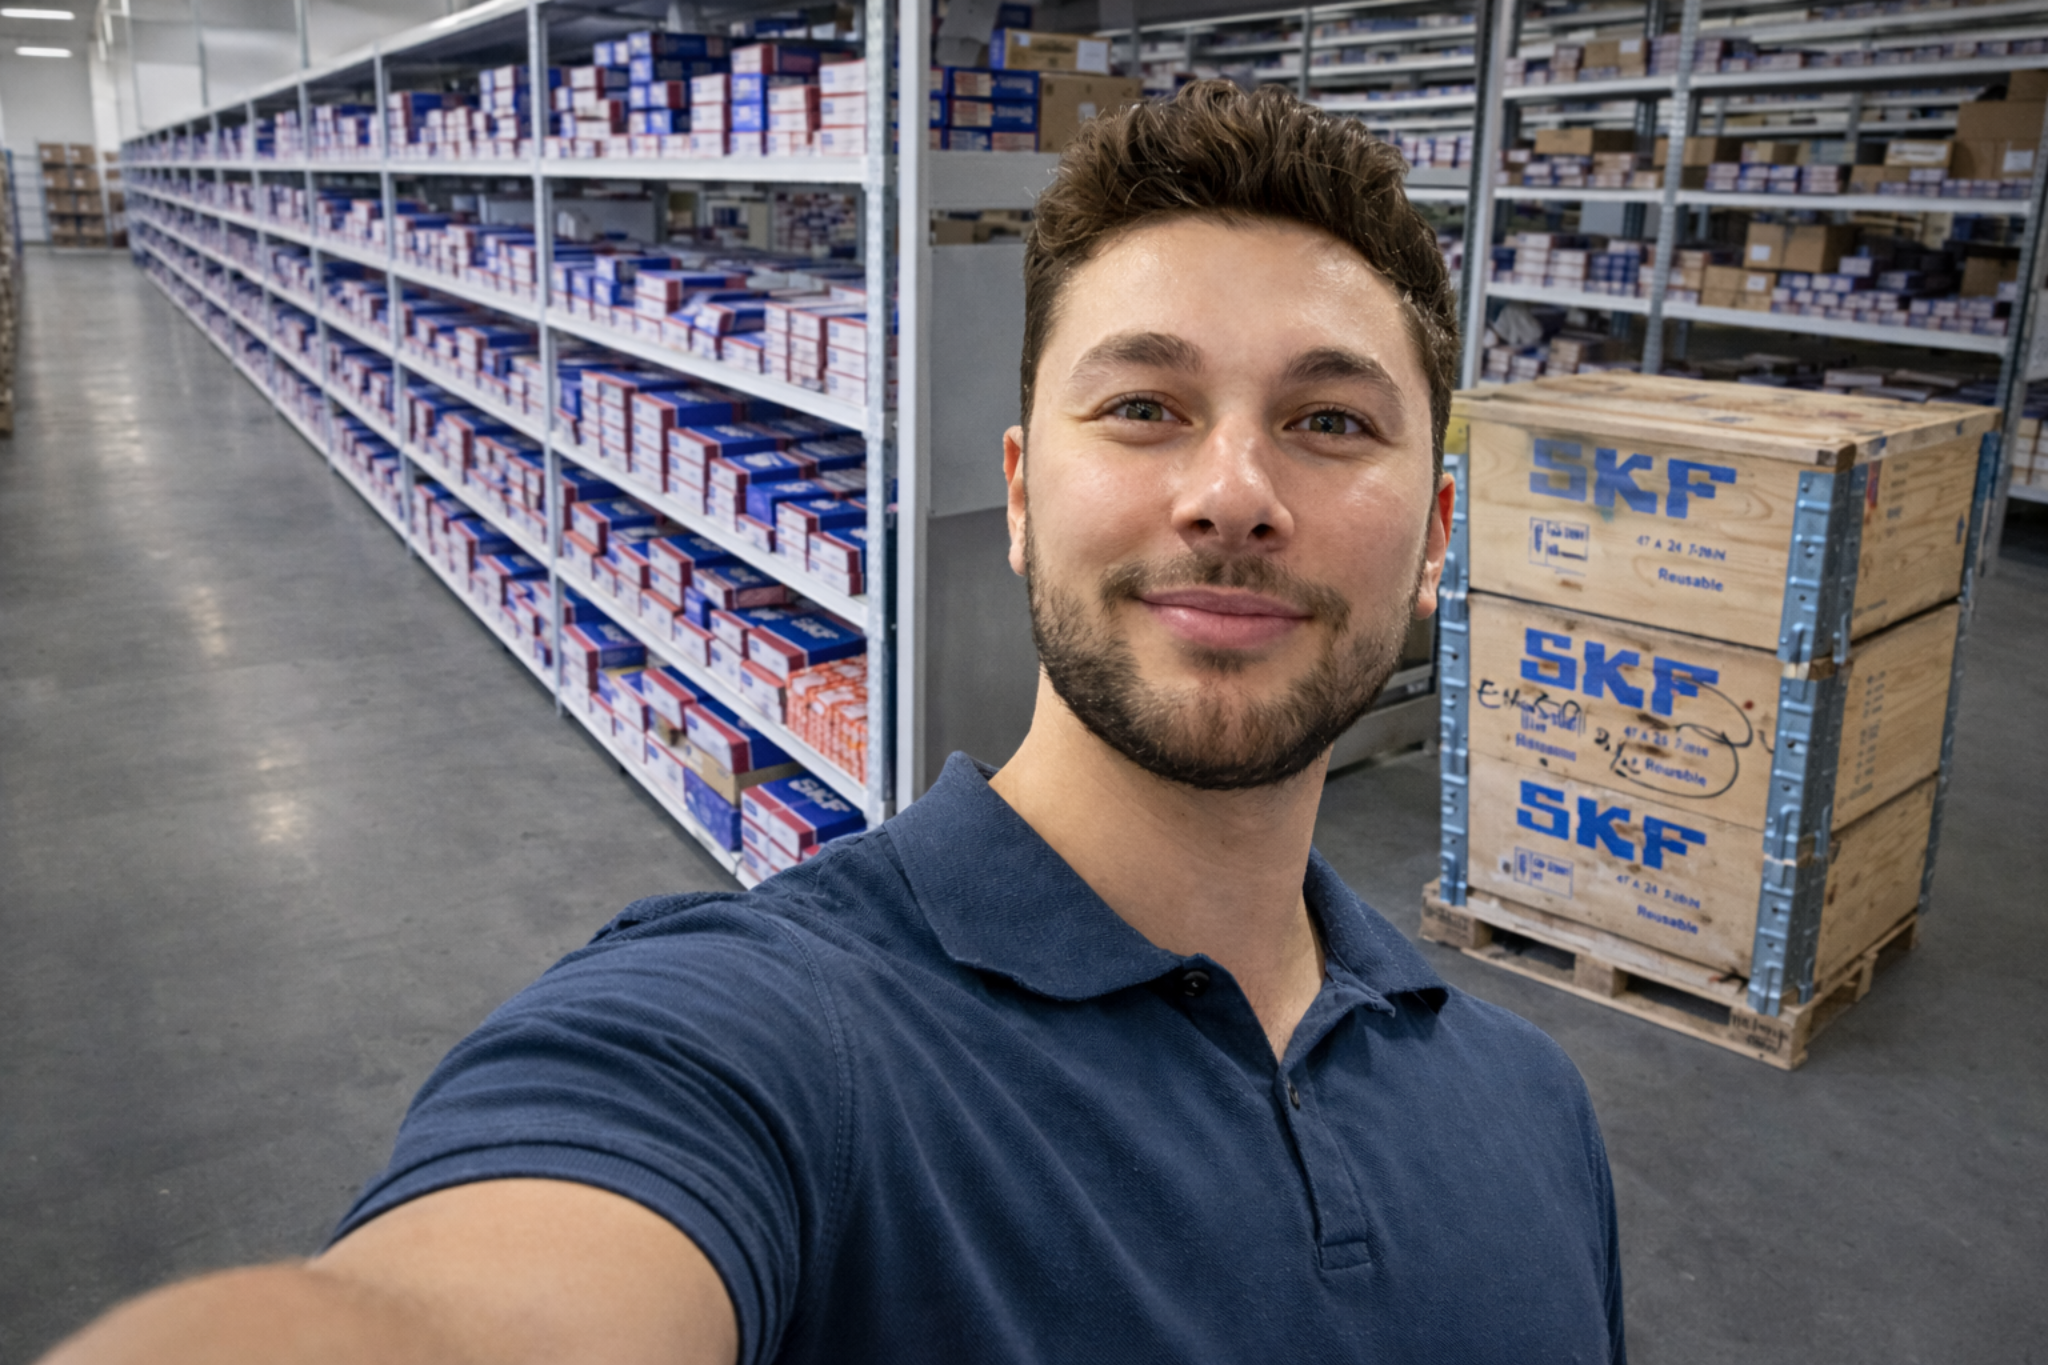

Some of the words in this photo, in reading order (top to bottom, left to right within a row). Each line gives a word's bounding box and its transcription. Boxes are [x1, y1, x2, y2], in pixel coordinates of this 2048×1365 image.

[1529, 438, 1737, 519] SKF
[1658, 567, 1724, 592] Reusable
[1519, 628, 1719, 717] SKF
[787, 777, 852, 813] SKF
[1516, 780, 1707, 870] SKF
[1637, 904, 1699, 935] Reusable
